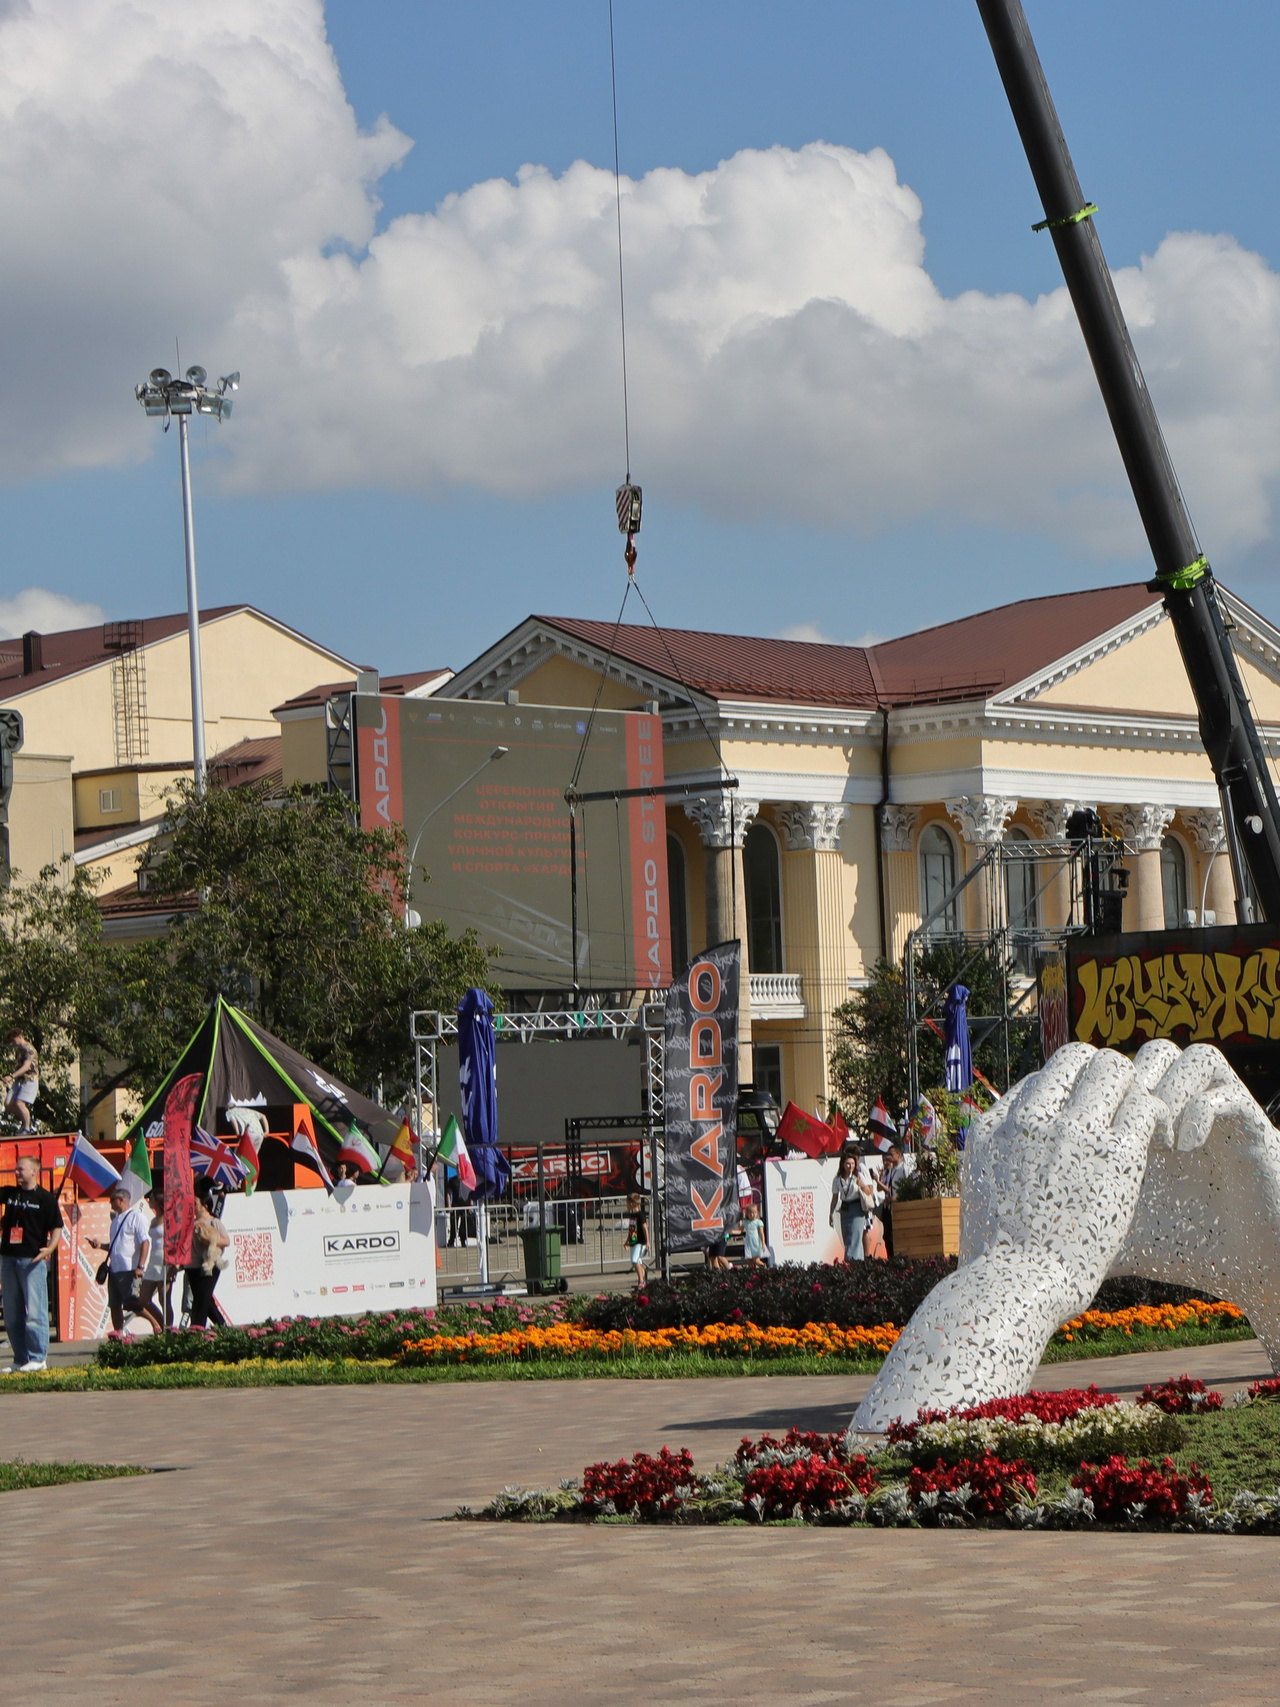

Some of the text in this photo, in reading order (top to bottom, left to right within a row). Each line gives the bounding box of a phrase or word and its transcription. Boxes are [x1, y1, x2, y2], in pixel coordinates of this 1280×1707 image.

[374, 706, 391, 833] АРДО
[475, 784, 560, 798] ЦЕРЕМОНИЯ
[480, 799, 556, 812] ОТКРЫТИЯ
[448, 844, 589, 859] УЛИЧНОЙ КУЛЬТУЫ
[452, 862, 462, 872] И
[465, 861, 520, 873] СПОРТА
[688, 961, 724, 1231] KARDO
[327, 1236, 396, 1251] KARDO
